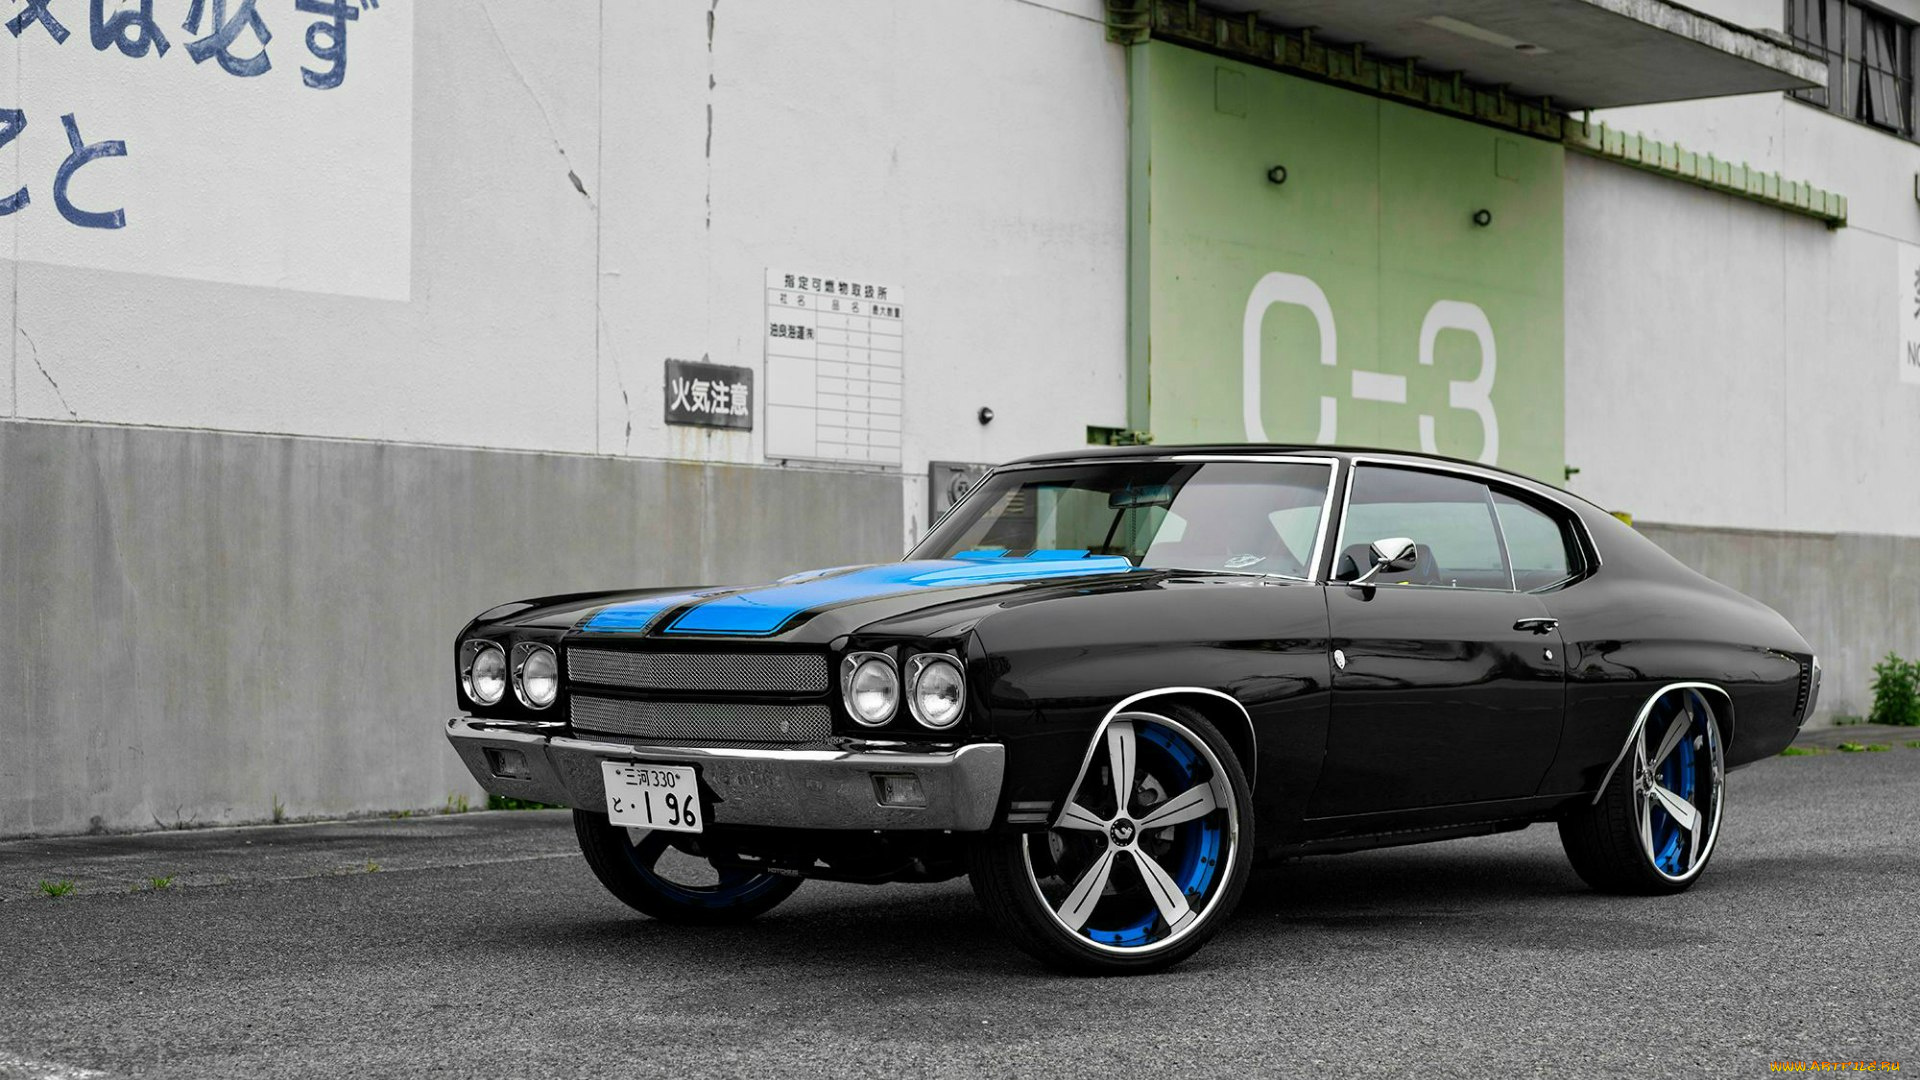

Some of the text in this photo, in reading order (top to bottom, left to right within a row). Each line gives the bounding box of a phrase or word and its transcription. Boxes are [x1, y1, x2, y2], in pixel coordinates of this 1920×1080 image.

[670, 376, 749, 416] 火気注意
[1243, 271, 1499, 466] C-3
